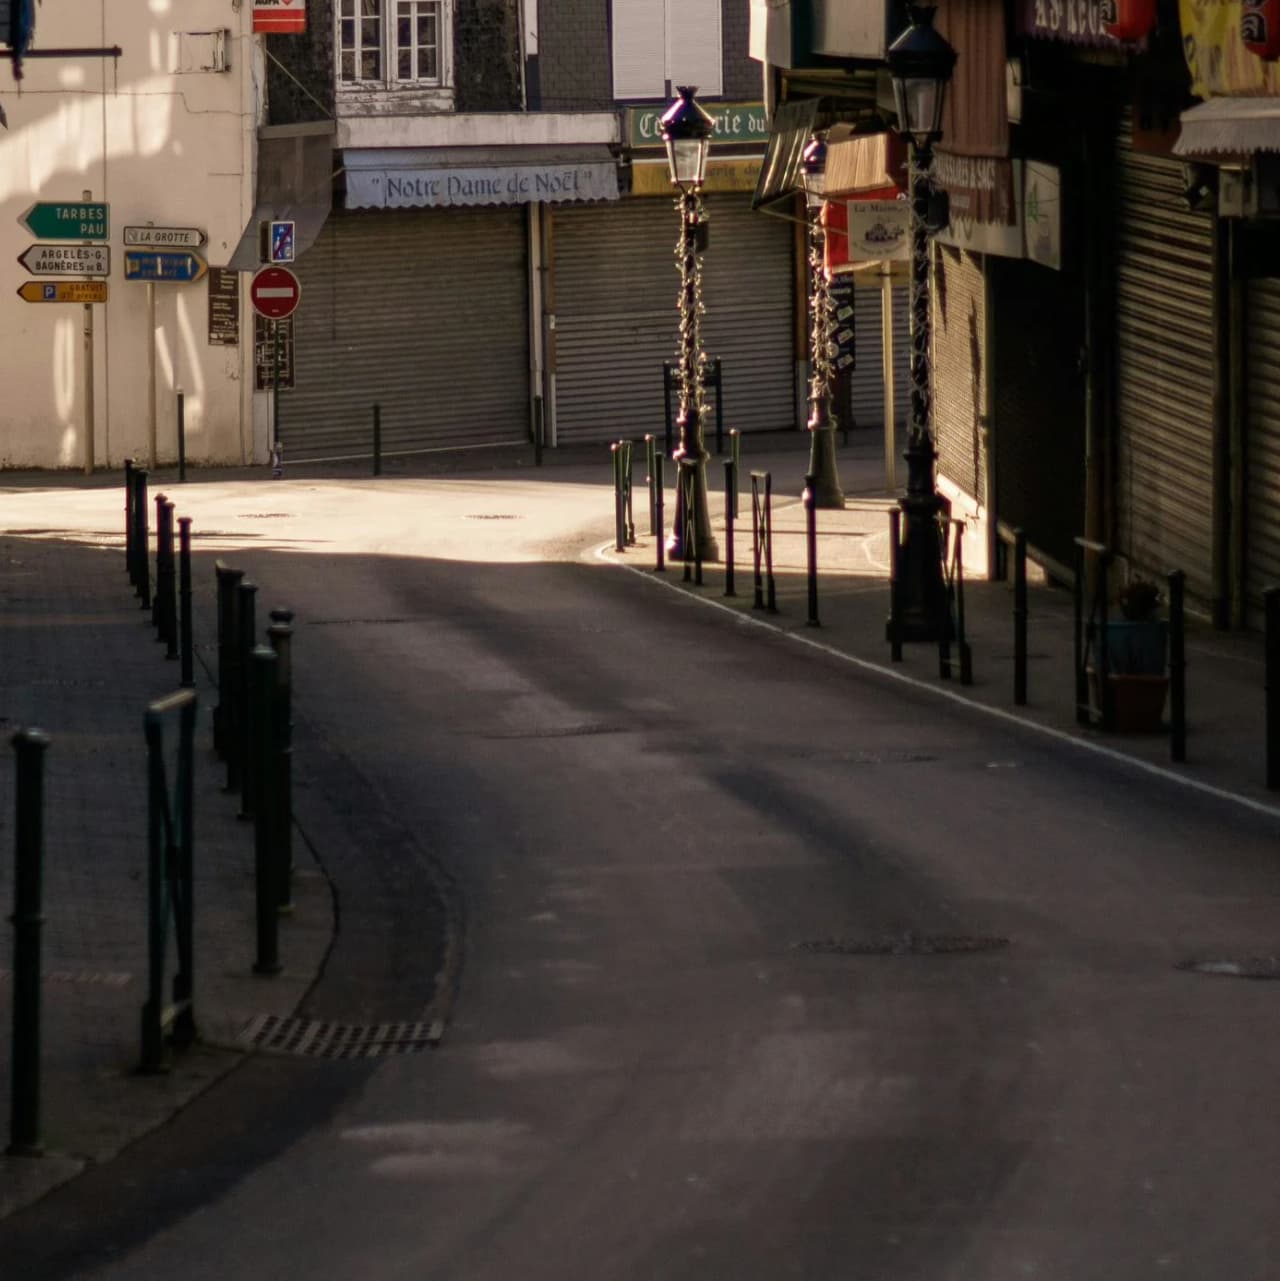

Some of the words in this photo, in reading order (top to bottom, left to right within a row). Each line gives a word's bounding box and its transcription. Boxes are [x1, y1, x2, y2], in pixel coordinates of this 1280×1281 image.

[748, 113, 766, 134] du
[447, 175, 502, 196] Dame
[506, 172, 529, 193] de
[56, 207, 104, 220] TARBES
[80, 223, 104, 234] PAU
[140, 232, 152, 241] LA
[155, 232, 190, 243] GROTTE
[35, 260, 84, 271] BAGNÈRES
[45, 286, 54, 297] P
